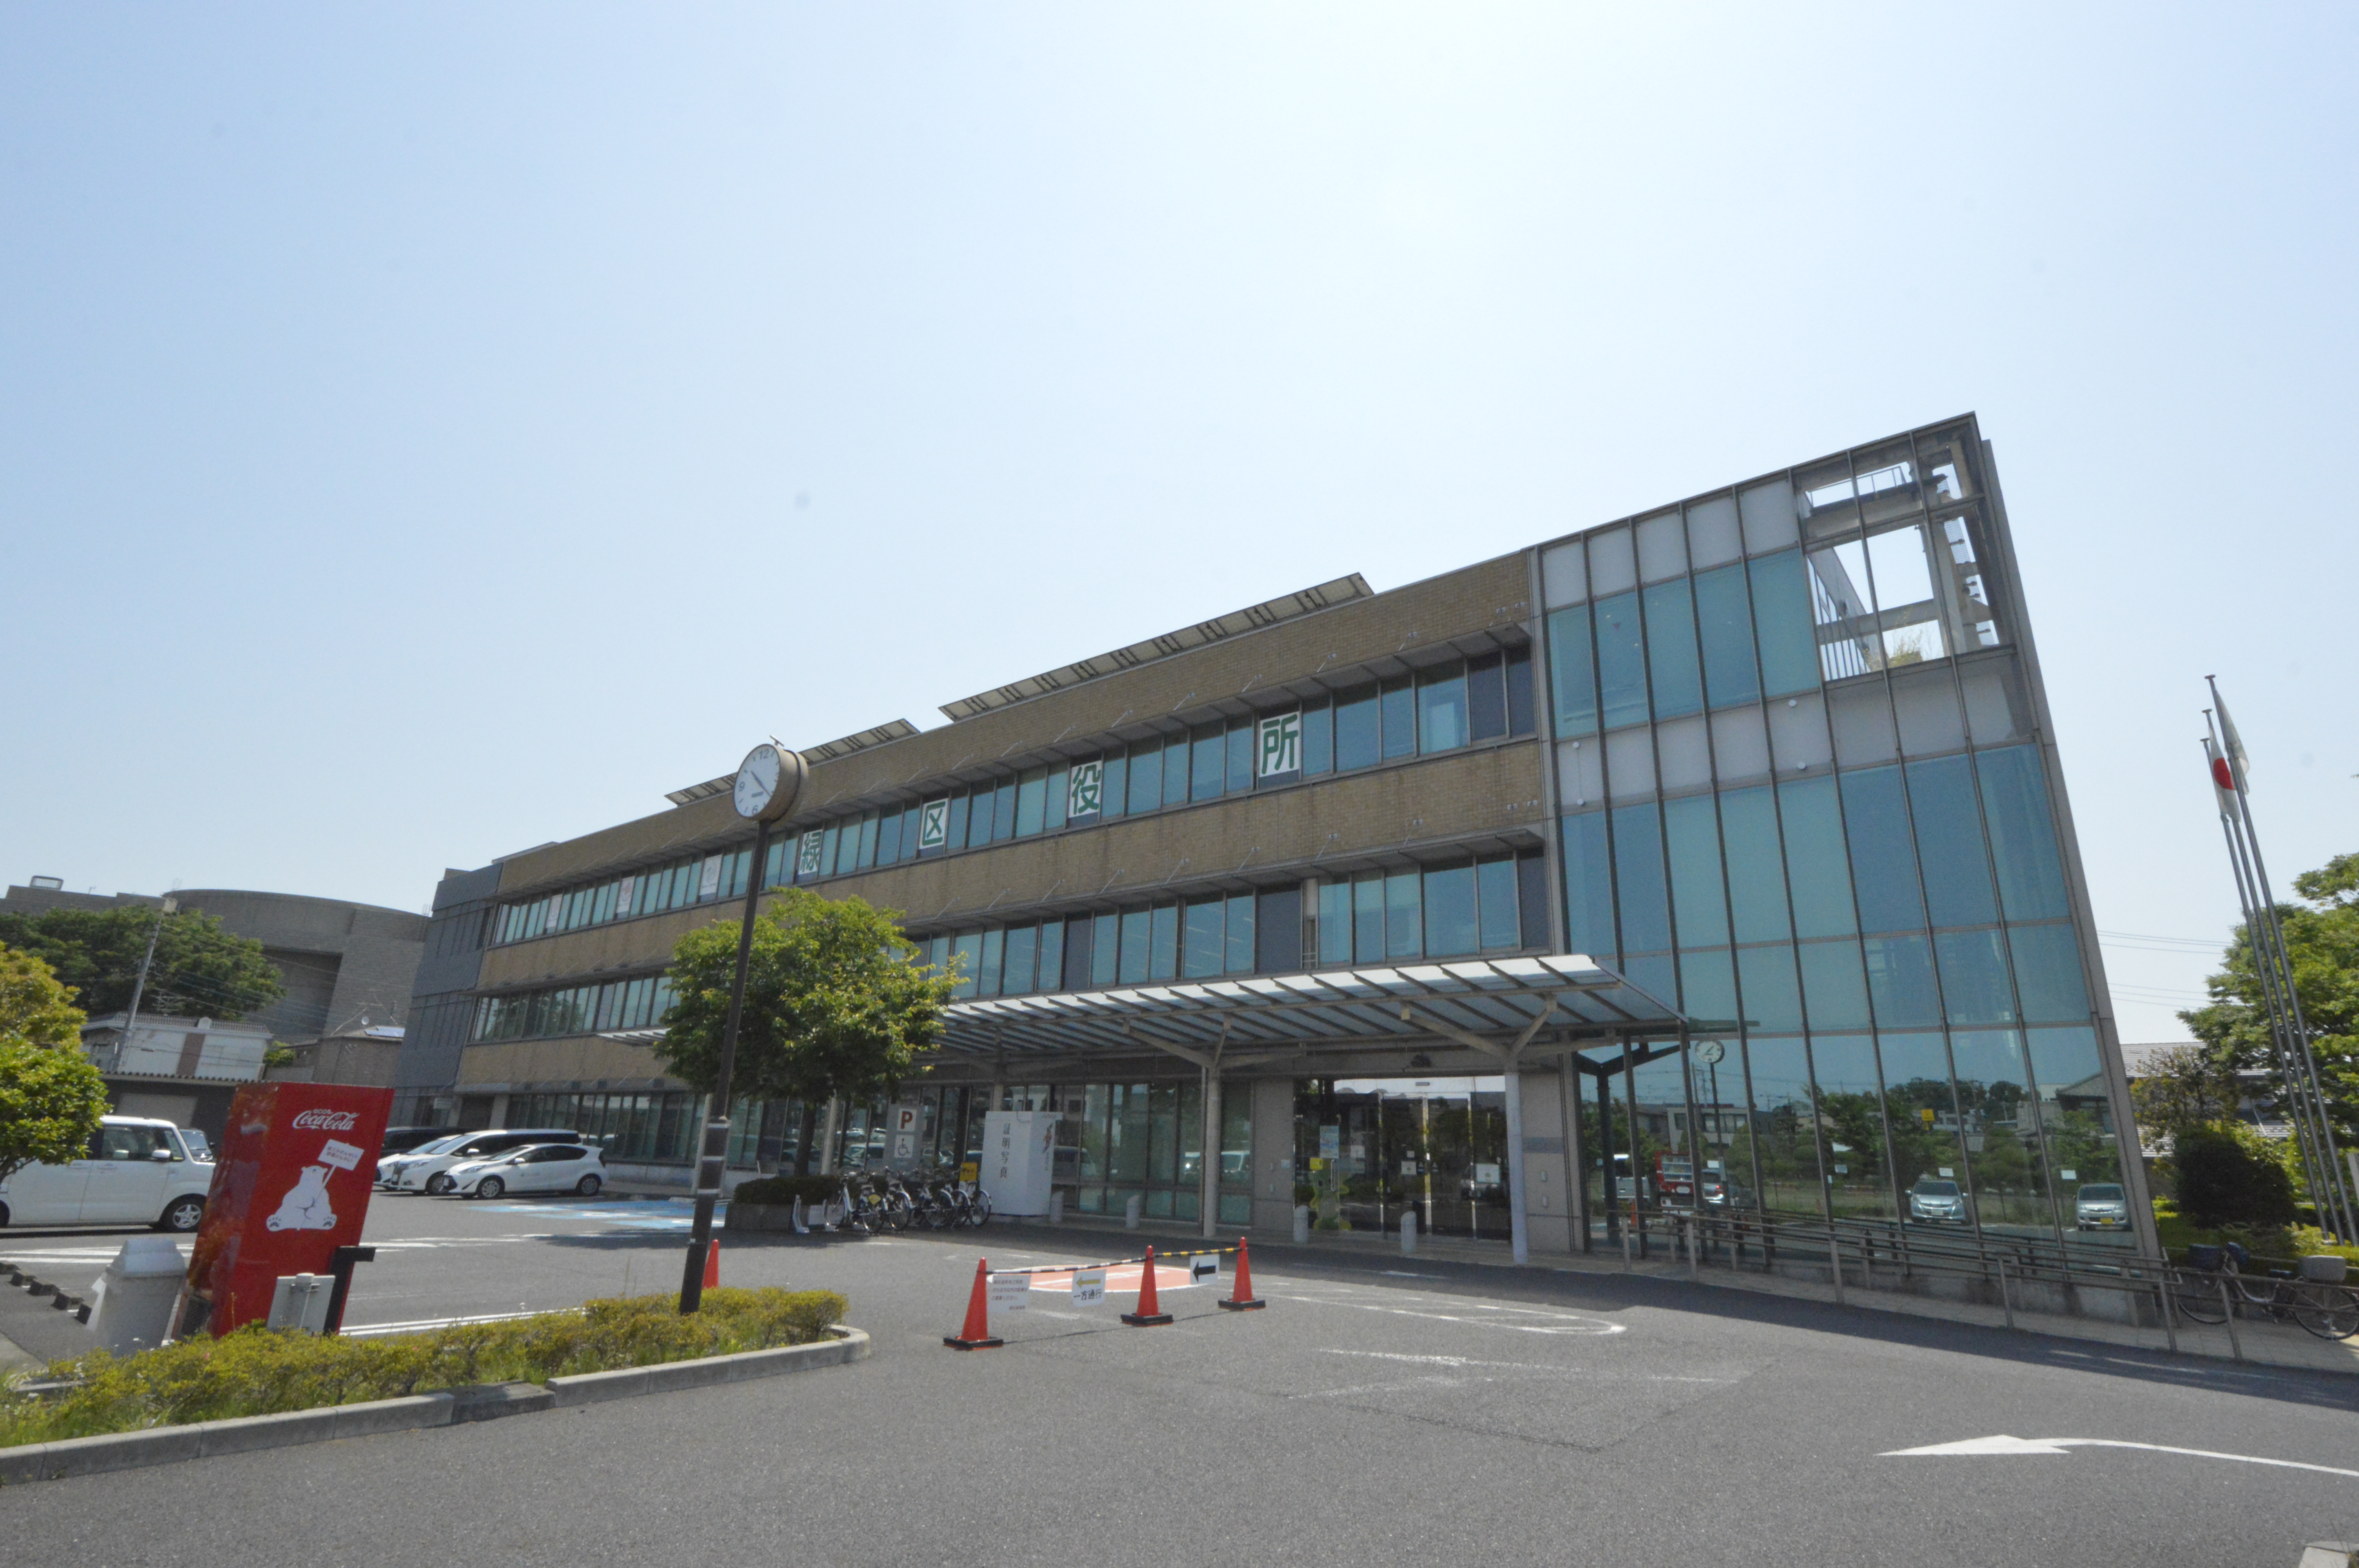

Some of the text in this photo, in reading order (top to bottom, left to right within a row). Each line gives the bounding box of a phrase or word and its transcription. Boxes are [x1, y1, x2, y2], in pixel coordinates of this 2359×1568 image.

[759, 748, 769, 760] 12
[739, 781, 745, 791] 9
[800, 713, 1299, 873] 緑 区 役 所
[752, 805, 758, 815] 6
[292, 1110, 361, 1131] Coca-Cola
[900, 1111, 913, 1129] P
[1000, 1123, 1010, 1178] 証明写真
[1073, 1288, 1102, 1301] 一方通行
